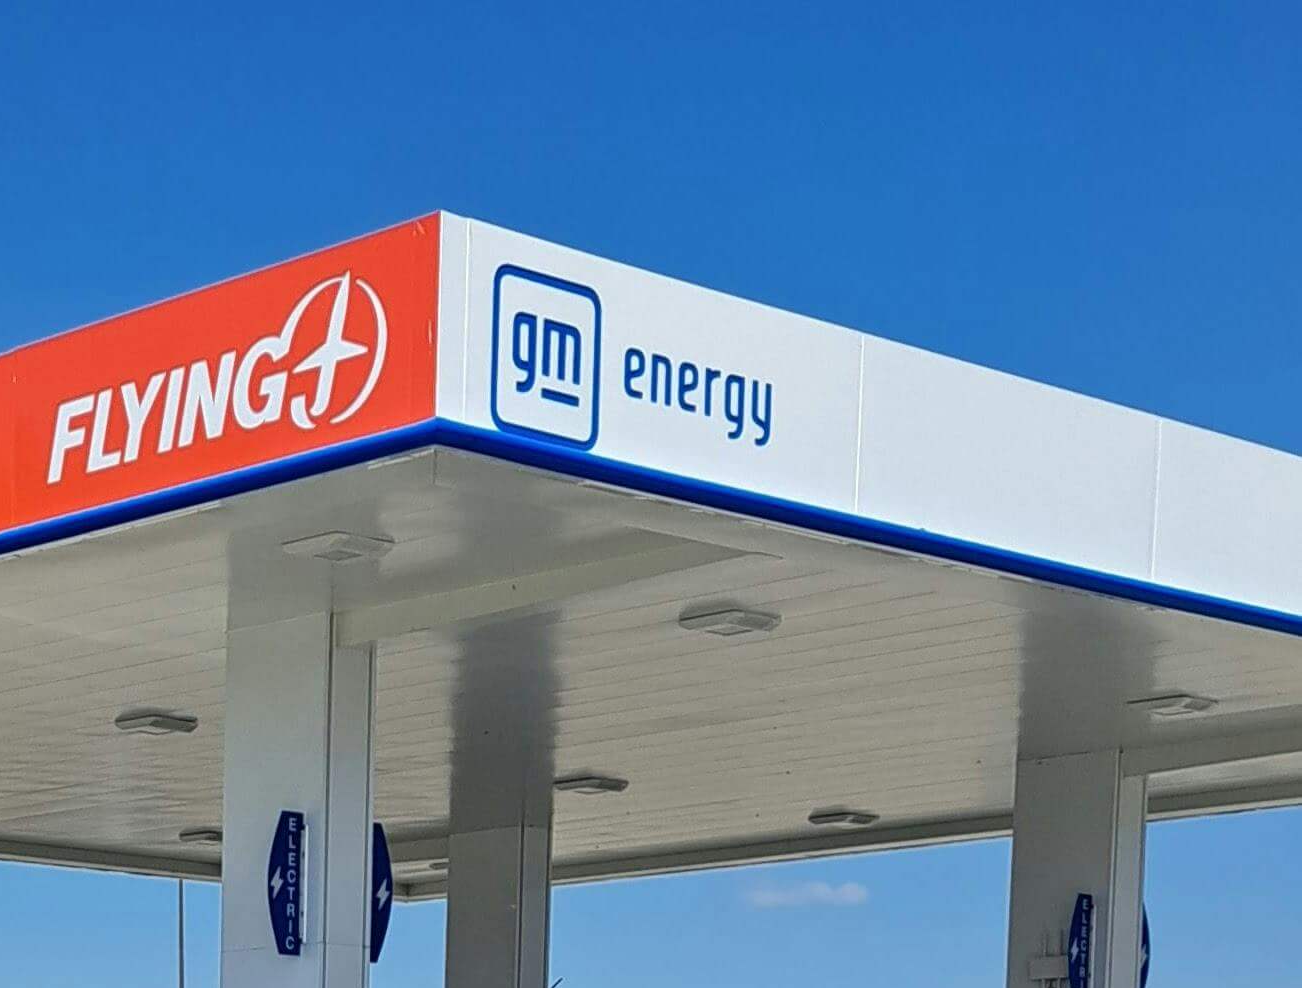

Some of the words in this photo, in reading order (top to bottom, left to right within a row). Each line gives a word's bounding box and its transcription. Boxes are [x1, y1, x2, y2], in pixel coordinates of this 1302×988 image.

[47, 335, 289, 486] FLYING
[511, 310, 583, 407] gm
[623, 346, 774, 448] energy
[285, 817, 297, 950] ELECTRIC
